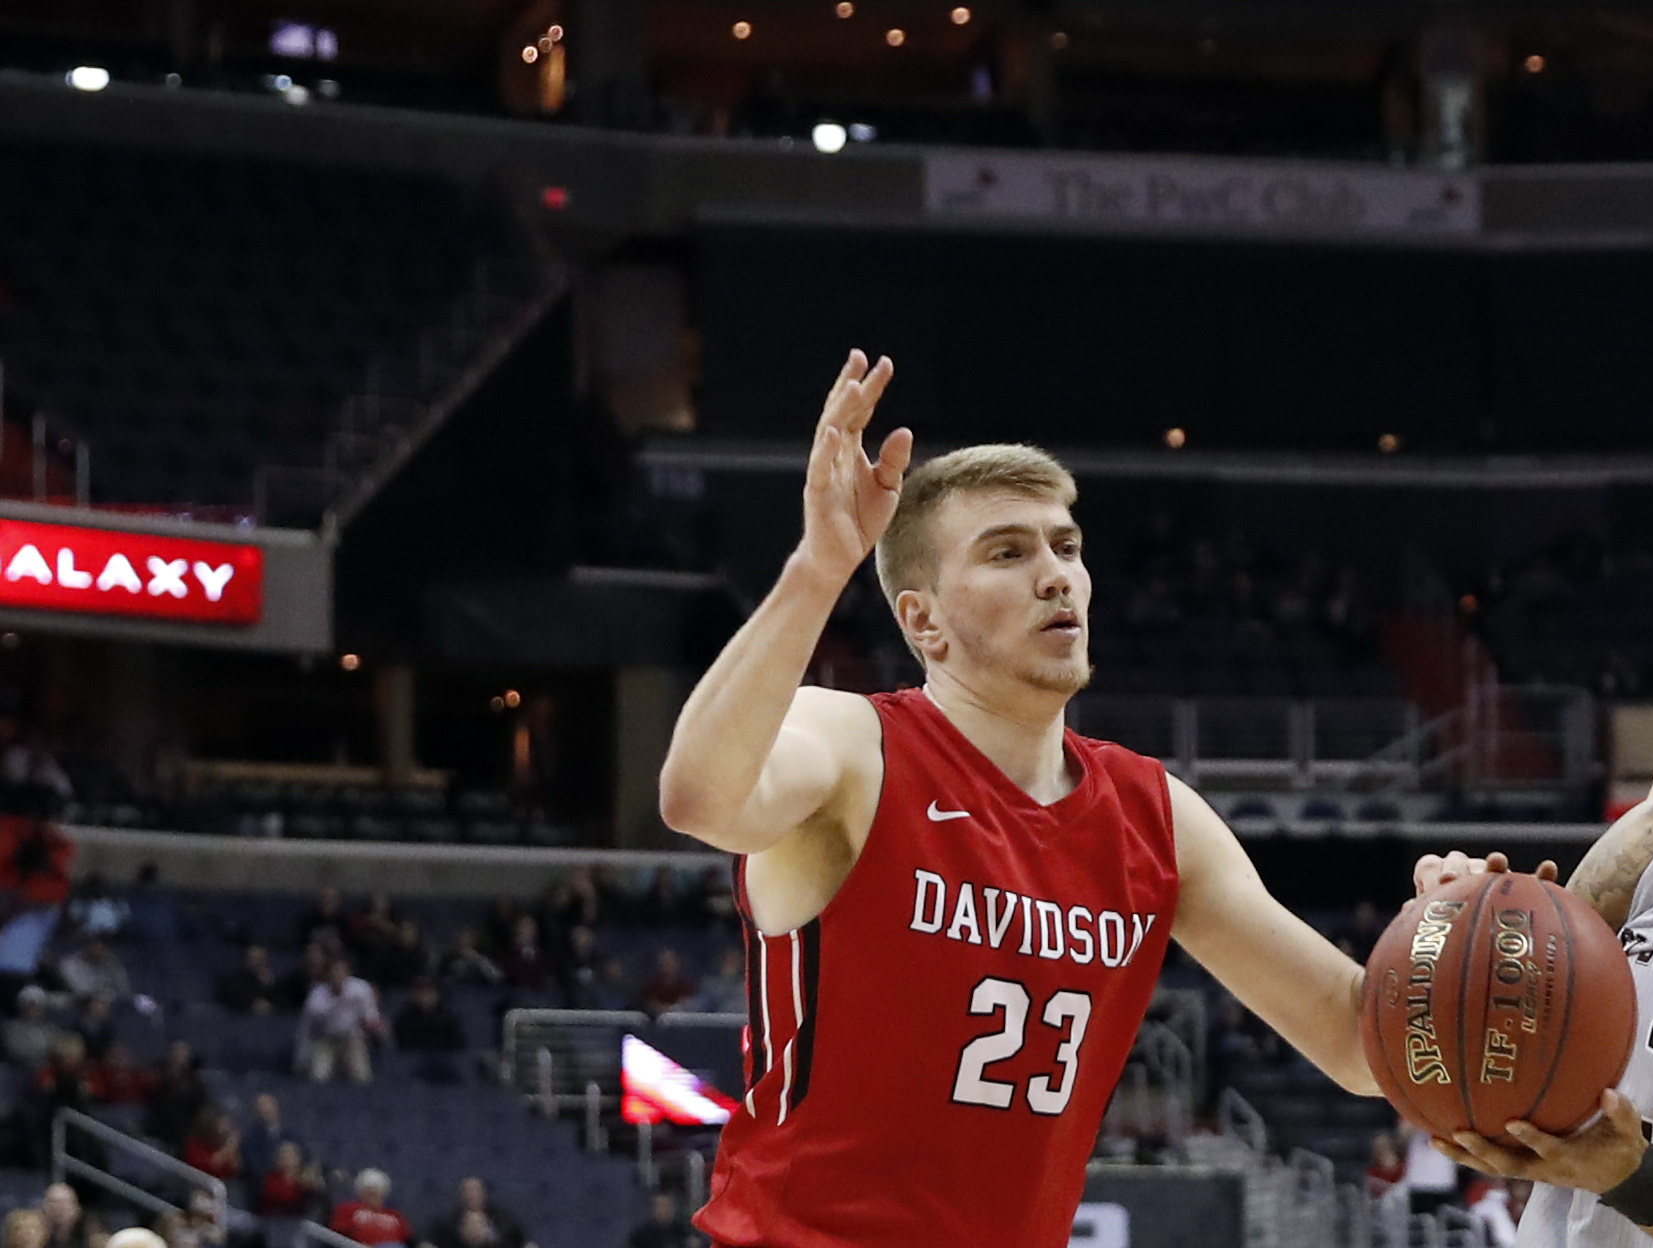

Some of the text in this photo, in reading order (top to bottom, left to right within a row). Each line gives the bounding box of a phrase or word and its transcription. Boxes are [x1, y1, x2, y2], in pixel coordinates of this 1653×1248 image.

[0, 543, 234, 602] ALAXY
[909, 868, 1156, 968] DAVIDSON
[950, 976, 1092, 1117] 23
[1405, 901, 1467, 1085] SPALDING
